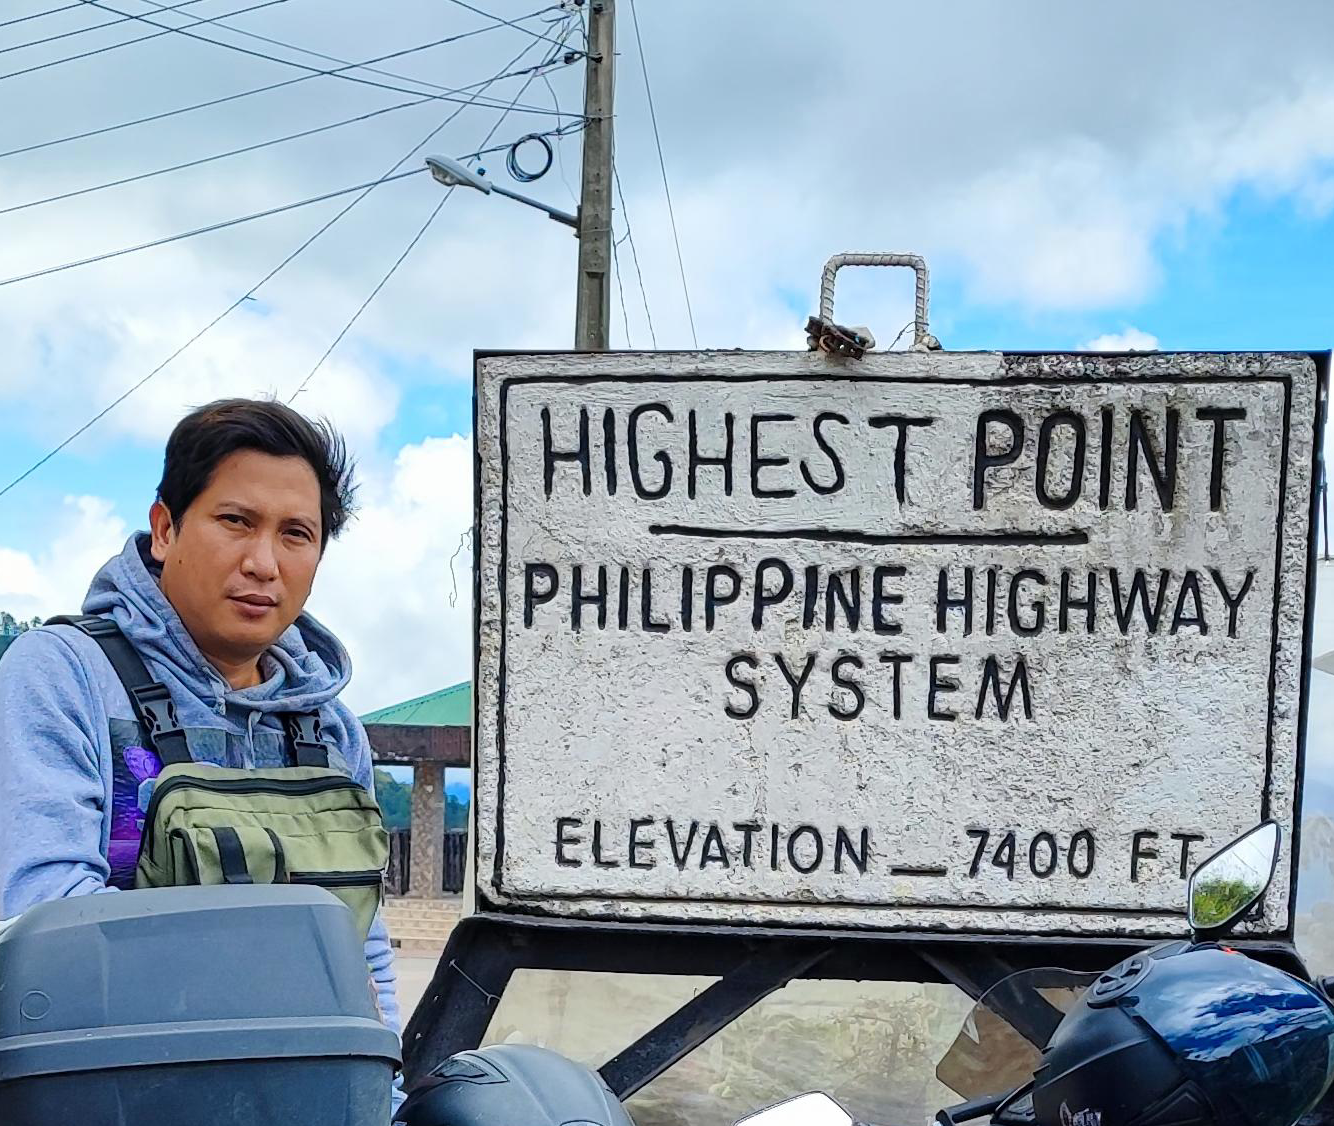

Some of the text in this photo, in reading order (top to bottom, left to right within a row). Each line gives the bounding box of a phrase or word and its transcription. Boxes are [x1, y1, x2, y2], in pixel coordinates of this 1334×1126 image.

[541, 402, 1247, 513] HIGHEST POINT
[523, 557, 1254, 639] PHILIPPINE HIGHWAY
[724, 652, 1033, 723] SYSTEM
[553, 817, 869, 876] ELEVATION
[966, 829, 1096, 879] 7400
[1130, 829, 1205, 882] FT
